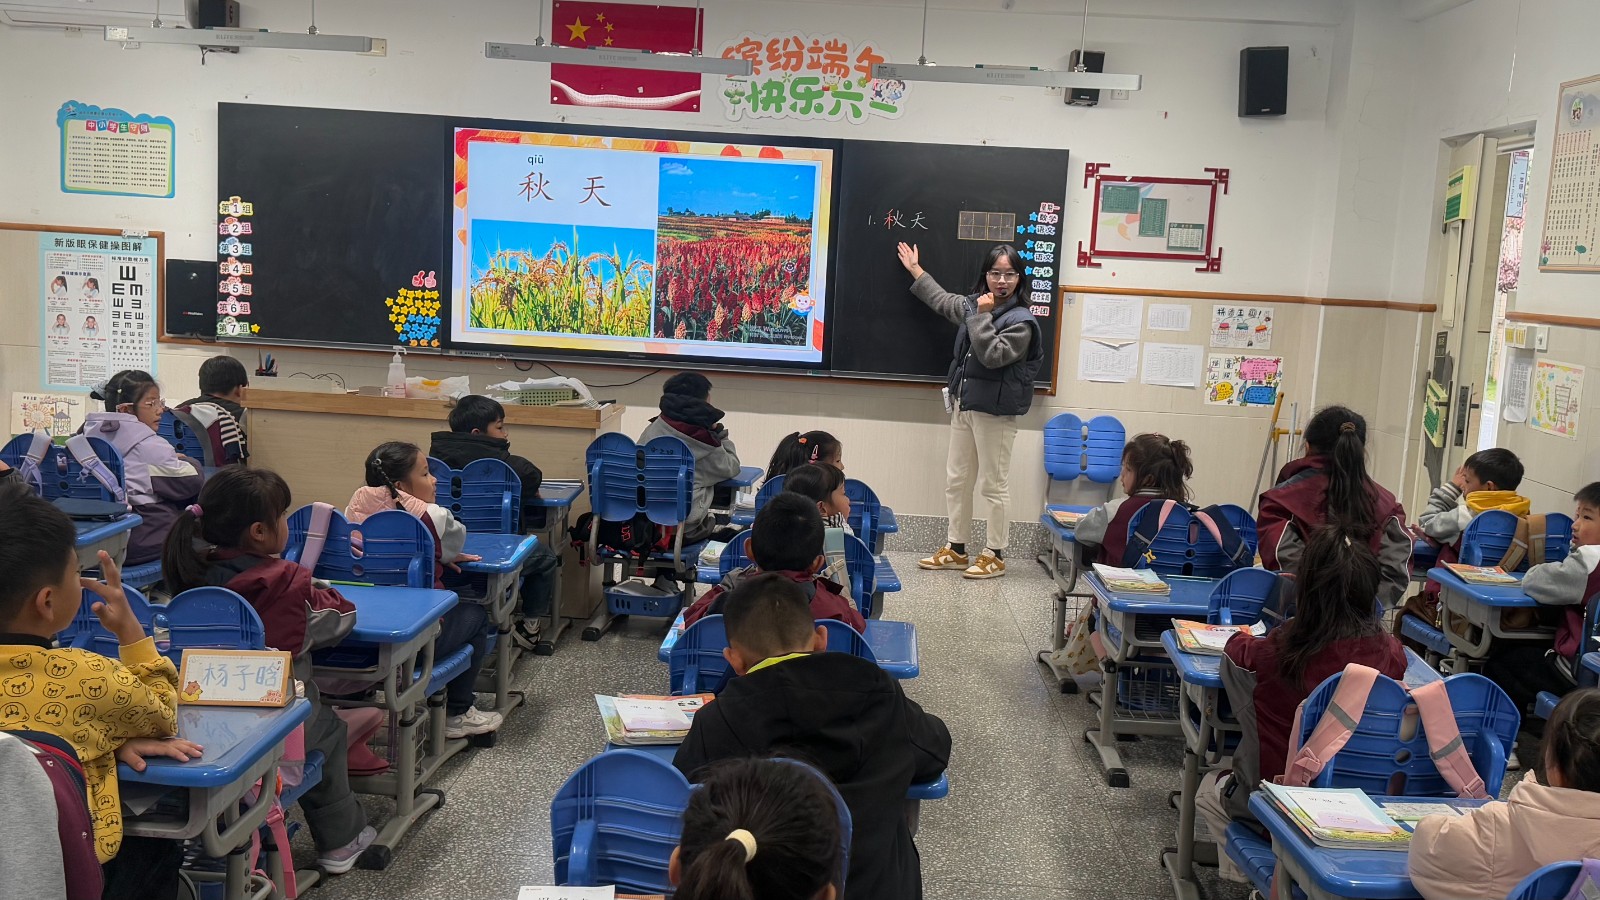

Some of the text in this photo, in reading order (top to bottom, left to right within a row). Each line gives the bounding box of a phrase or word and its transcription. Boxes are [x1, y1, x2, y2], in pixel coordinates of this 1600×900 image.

[722, 36, 884, 82] 缤纷端午
[745, 77, 898, 119] 快乐六一
[87, 120, 149, 133] 中小学生守则
[527, 154, 544, 165] qiū
[517, 171, 612, 206] 秋天
[220, 203, 252, 214] 第1组
[1040, 203, 1060, 212] 星期一
[883, 208, 929, 230] 秋天
[1039, 213, 1057, 222] 数学
[220, 223, 251, 234] 第2组
[1036, 225, 1055, 235] 语文
[54, 237, 142, 252] 新版眼保健操图解
[220, 243, 251, 254] 第3组
[1035, 241, 1054, 251] 体育
[1034, 253, 1053, 262] 语文
[221, 263, 251, 274] 第4组
[1033, 267, 1052, 276] 午休
[221, 282, 251, 294] 第5组
[1032, 280, 1051, 289] 语文
[218, 302, 249, 313] 第6组
[218, 322, 248, 334] 第7组
[202, 661, 277, 691] 杨子晗
